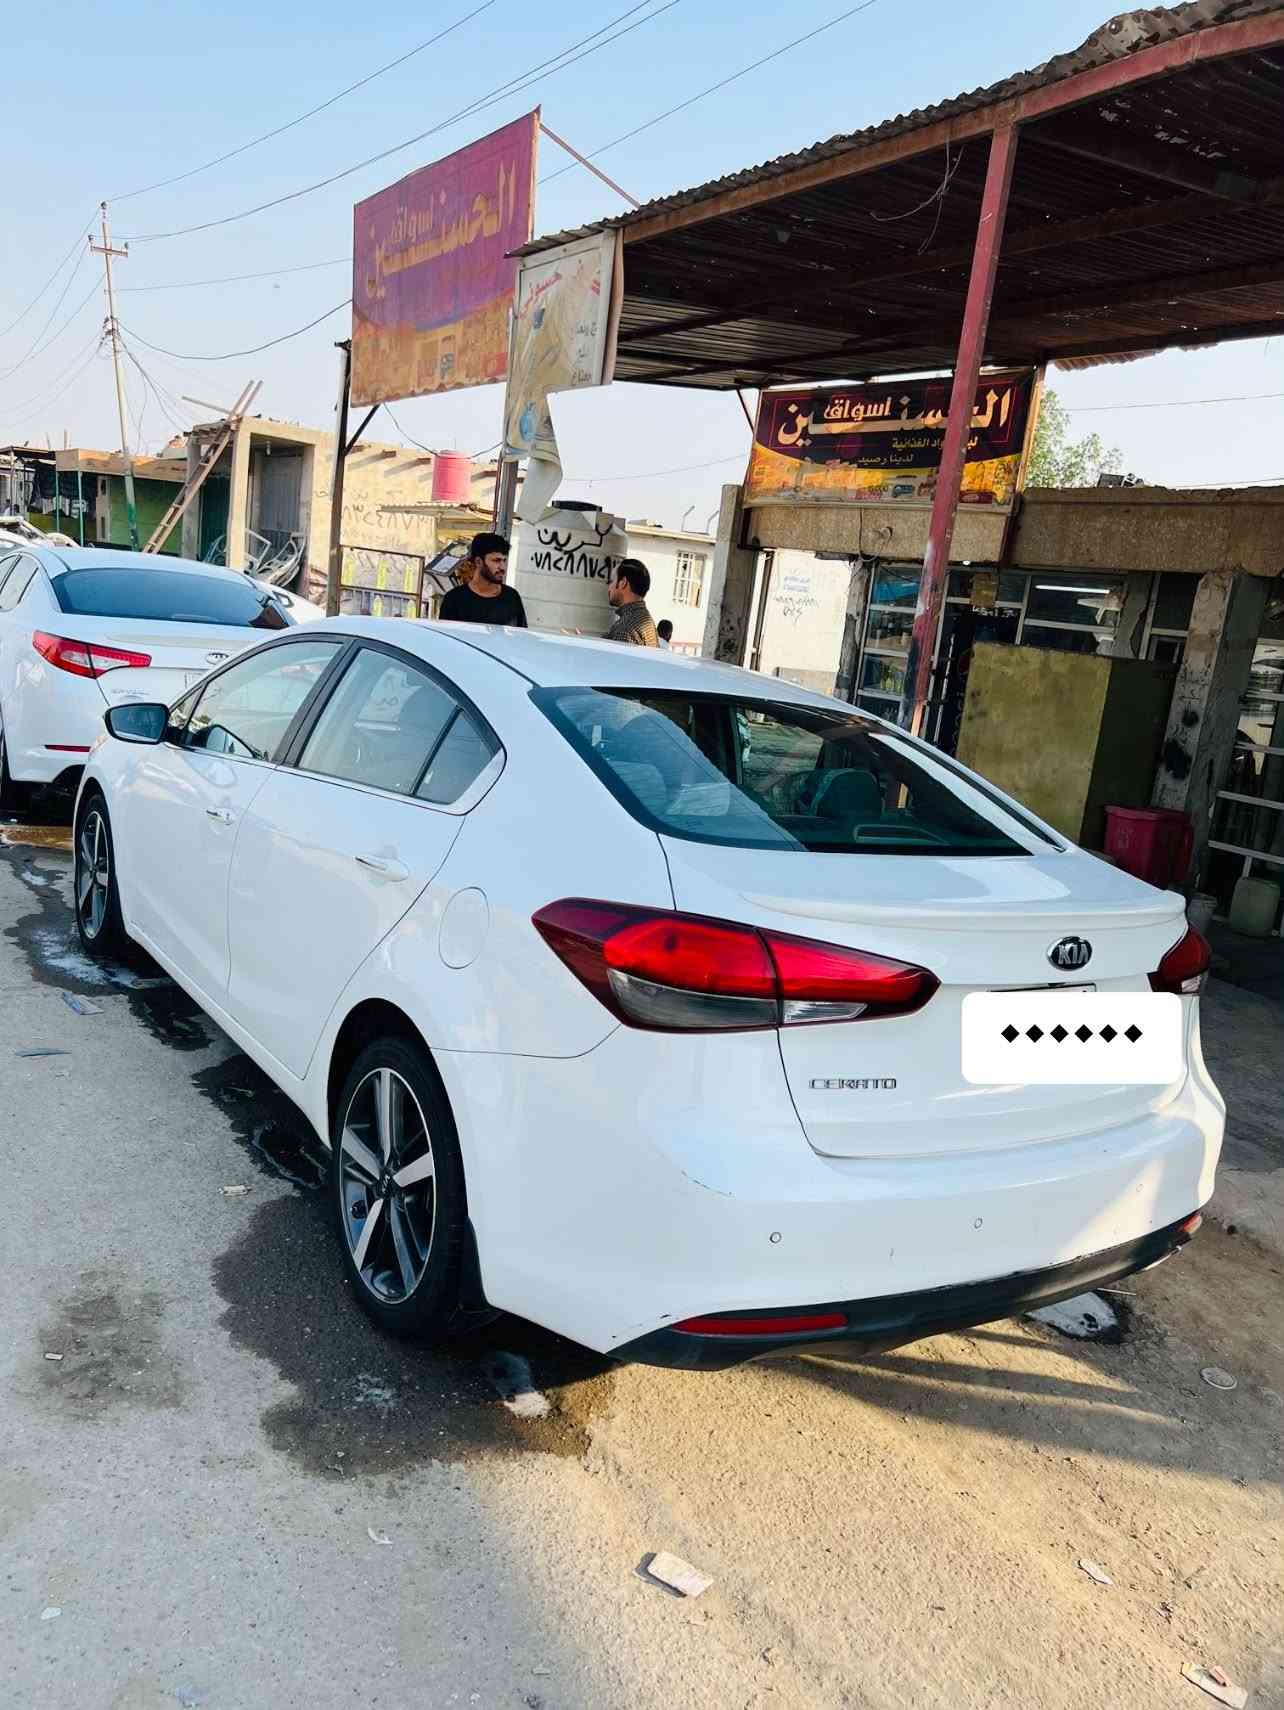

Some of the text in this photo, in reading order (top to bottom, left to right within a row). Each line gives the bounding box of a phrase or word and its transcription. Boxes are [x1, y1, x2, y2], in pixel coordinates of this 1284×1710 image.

[778, 387, 1011, 447] السنين
[824, 396, 892, 421] اسواق
[857, 453, 914, 466] لدينا رصيد
[1058, 943, 1089, 965] KIA
[809, 1078, 897, 1090] CERATO
